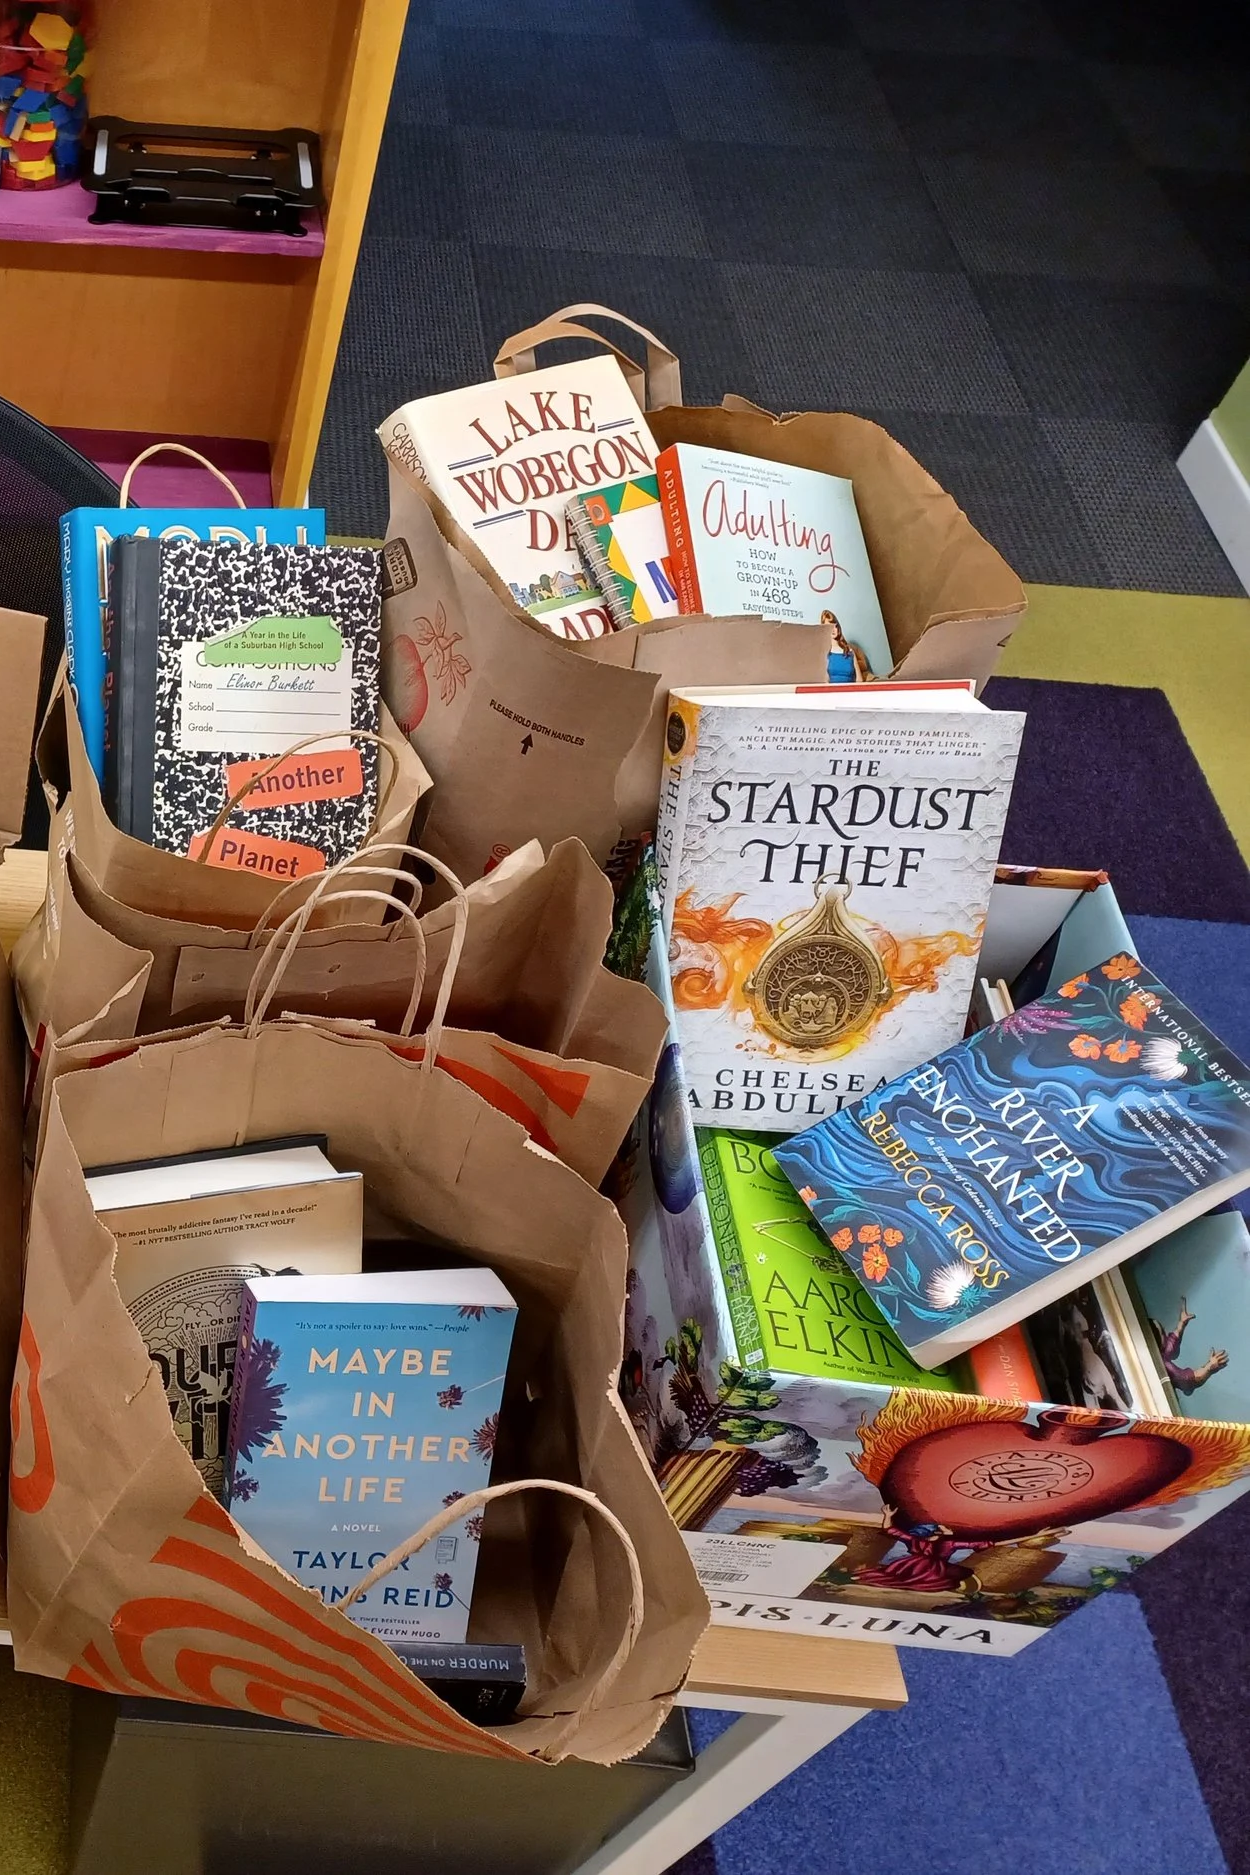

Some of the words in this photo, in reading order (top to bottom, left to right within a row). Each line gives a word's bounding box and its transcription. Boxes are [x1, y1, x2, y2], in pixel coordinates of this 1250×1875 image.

[470, 390, 596, 457] LAKE
[454, 431, 654, 514] WOBEGON
[663, 469, 684, 548] ADULTING
[702, 479, 850, 593] Adulting
[749, 548, 777, 562] HOW
[736, 572, 799, 590] GROWN-UP
[750, 589, 760, 597] IN
[762, 587, 792, 605] 468
[224, 641, 232, 649] of
[279, 642, 297, 650] High
[241, 631, 248, 639] A
[250, 631, 266, 639] Year
[268, 631, 276, 639] in
[278, 631, 290, 639] the
[292, 631, 306, 639] Life
[188, 680, 213, 690] Name
[226, 672, 263, 689] Elinor
[267, 675, 315, 692] Burkett
[188, 702, 215, 712] School
[188, 722, 214, 732] Grade
[489, 699, 514, 720] PLEASE
[513, 712, 532, 728] HOLD
[532, 721, 551, 737] BOTH
[551, 730, 586, 747] HANDLES
[248, 762, 346, 797] Another
[829, 759, 881, 777] THE
[707, 779, 997, 840] STARDUST
[219, 839, 299, 879] Planet
[739, 830, 925, 889] THIEF
[1121, 975, 1209, 1061] INTERNATIONAL
[715, 1068, 889, 1094] CHELSEA
[1060, 1103, 1099, 1132] A
[989, 1088, 1084, 1204] RIVER
[701, 1145, 724, 1192] OLD
[907, 1065, 1082, 1263] ENCHANTED
[860, 1109, 956, 1228] REBECCA
[946, 1221, 1010, 1290] ROSS
[711, 1190, 740, 1262] BONES
[308, 1347, 453, 1376] MAYBE
[351, 1391, 396, 1419] IN
[261, 1434, 471, 1464] ANOTHER
[318, 1476, 407, 1503] LIFE
[331, 1524, 339, 1532] A
[342, 1524, 382, 1533] NOVEL
[383, 1587, 455, 1609] REID
[370, 1627, 408, 1637] EVELYN
[411, 1629, 442, 1639] HUGO
[410, 1657, 429, 1666] THE
[431, 1657, 446, 1667] ON
[449, 1657, 510, 1671] MURDER
